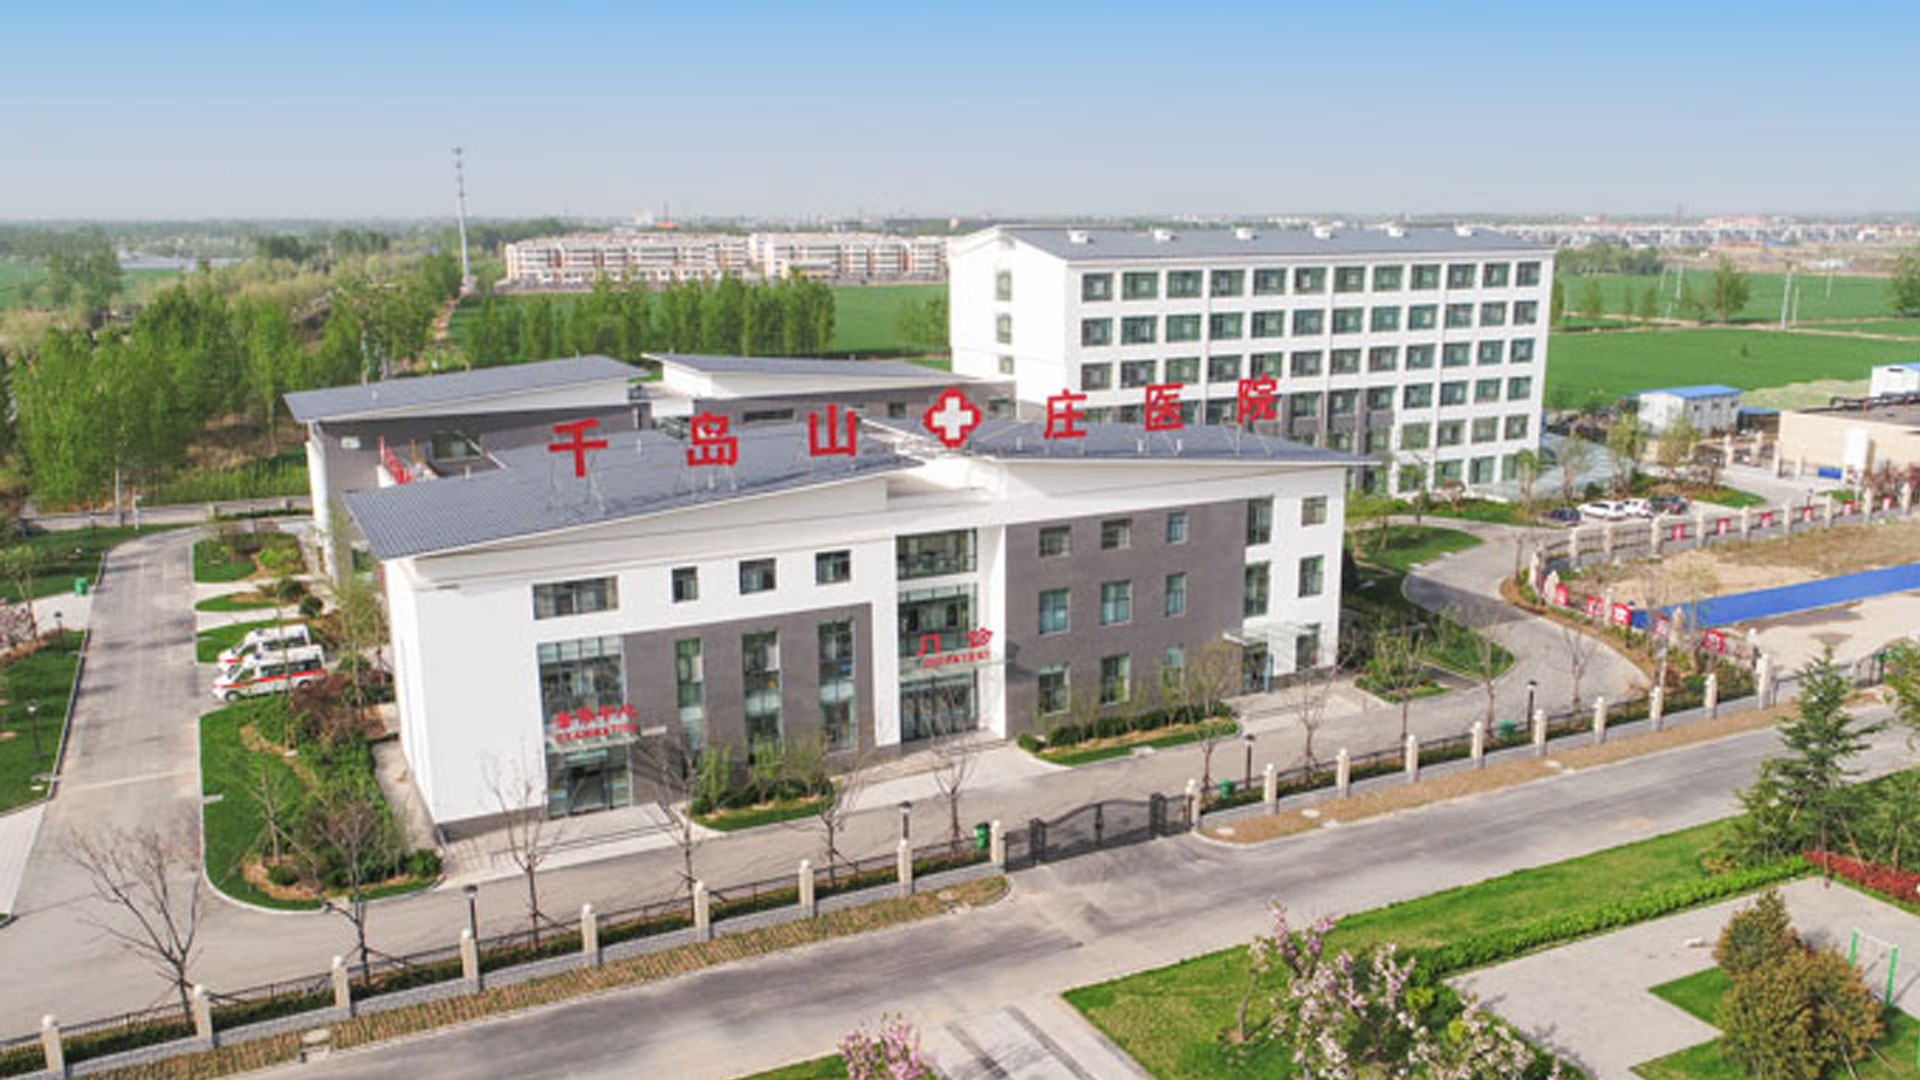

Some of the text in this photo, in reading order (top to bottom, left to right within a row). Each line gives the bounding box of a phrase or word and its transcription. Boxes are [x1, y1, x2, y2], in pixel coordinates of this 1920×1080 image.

[549, 374, 1277, 477] 千岛山庄医院
